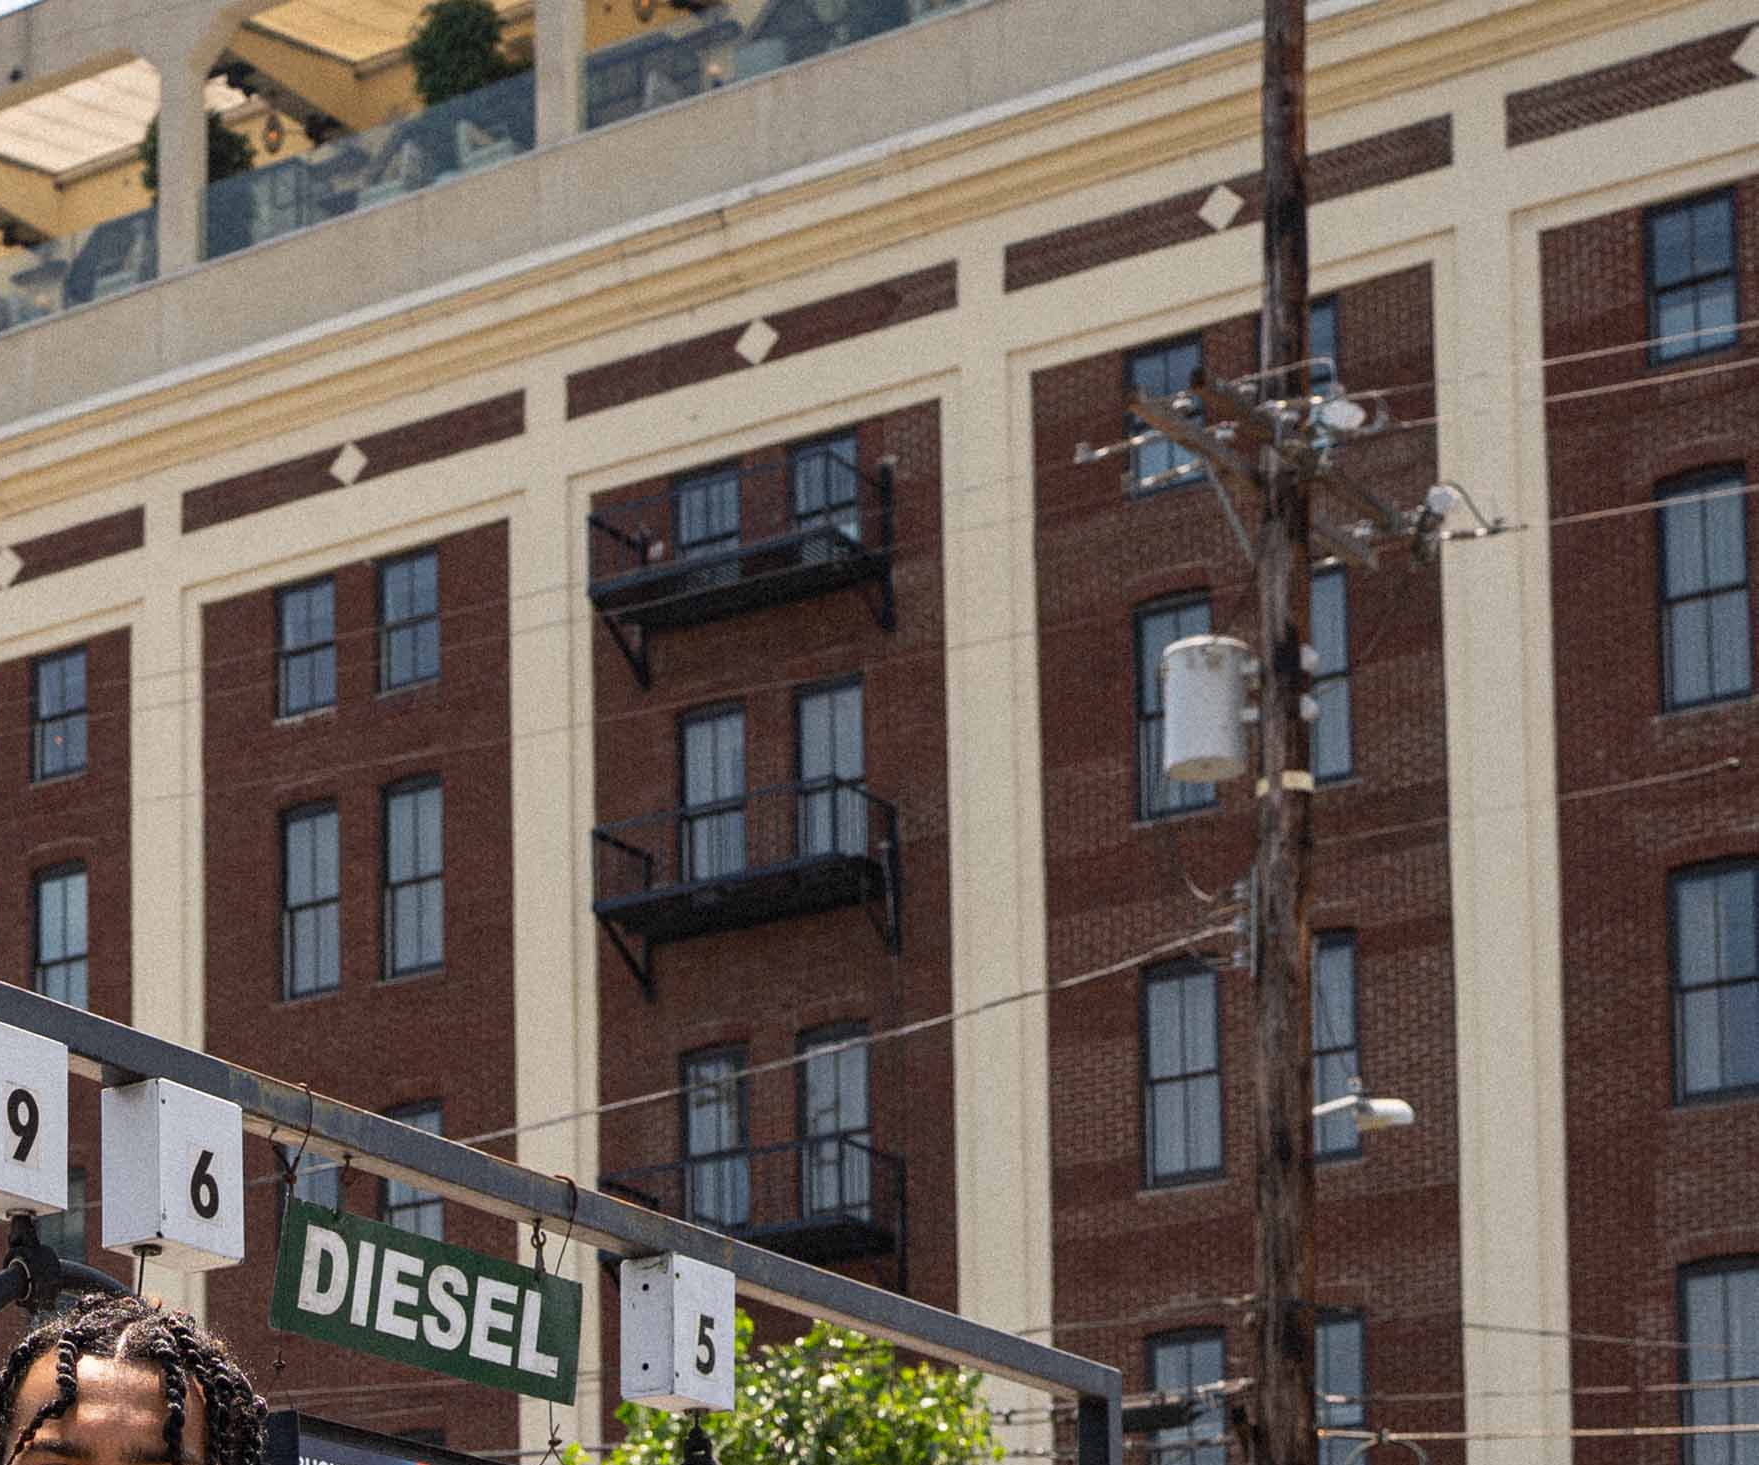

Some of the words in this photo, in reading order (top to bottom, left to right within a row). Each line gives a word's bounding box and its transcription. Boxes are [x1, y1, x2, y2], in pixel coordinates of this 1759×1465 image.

[6, 1088, 40, 1162] 9
[189, 1150, 220, 1218] 6
[297, 1223, 559, 1378] DIESEL
[694, 1316, 716, 1375] 5
